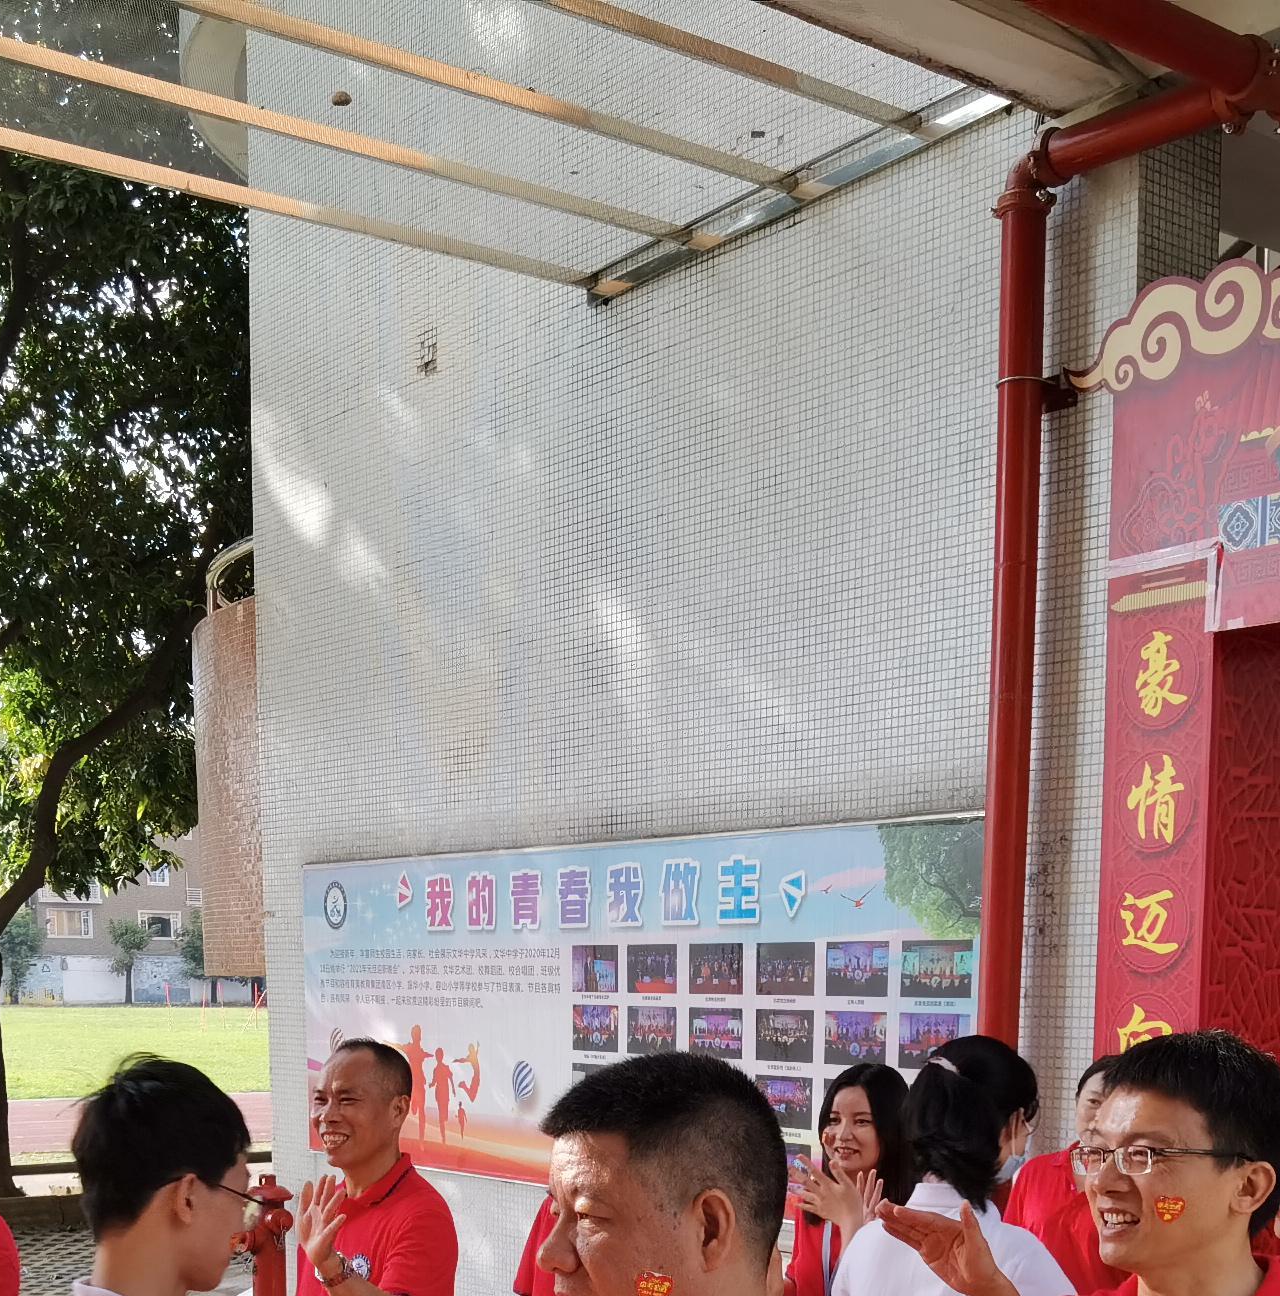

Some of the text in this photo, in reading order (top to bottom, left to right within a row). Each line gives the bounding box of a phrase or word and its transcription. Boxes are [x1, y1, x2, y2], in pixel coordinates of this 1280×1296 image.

[425, 856, 759, 930] 我的青春我做主
